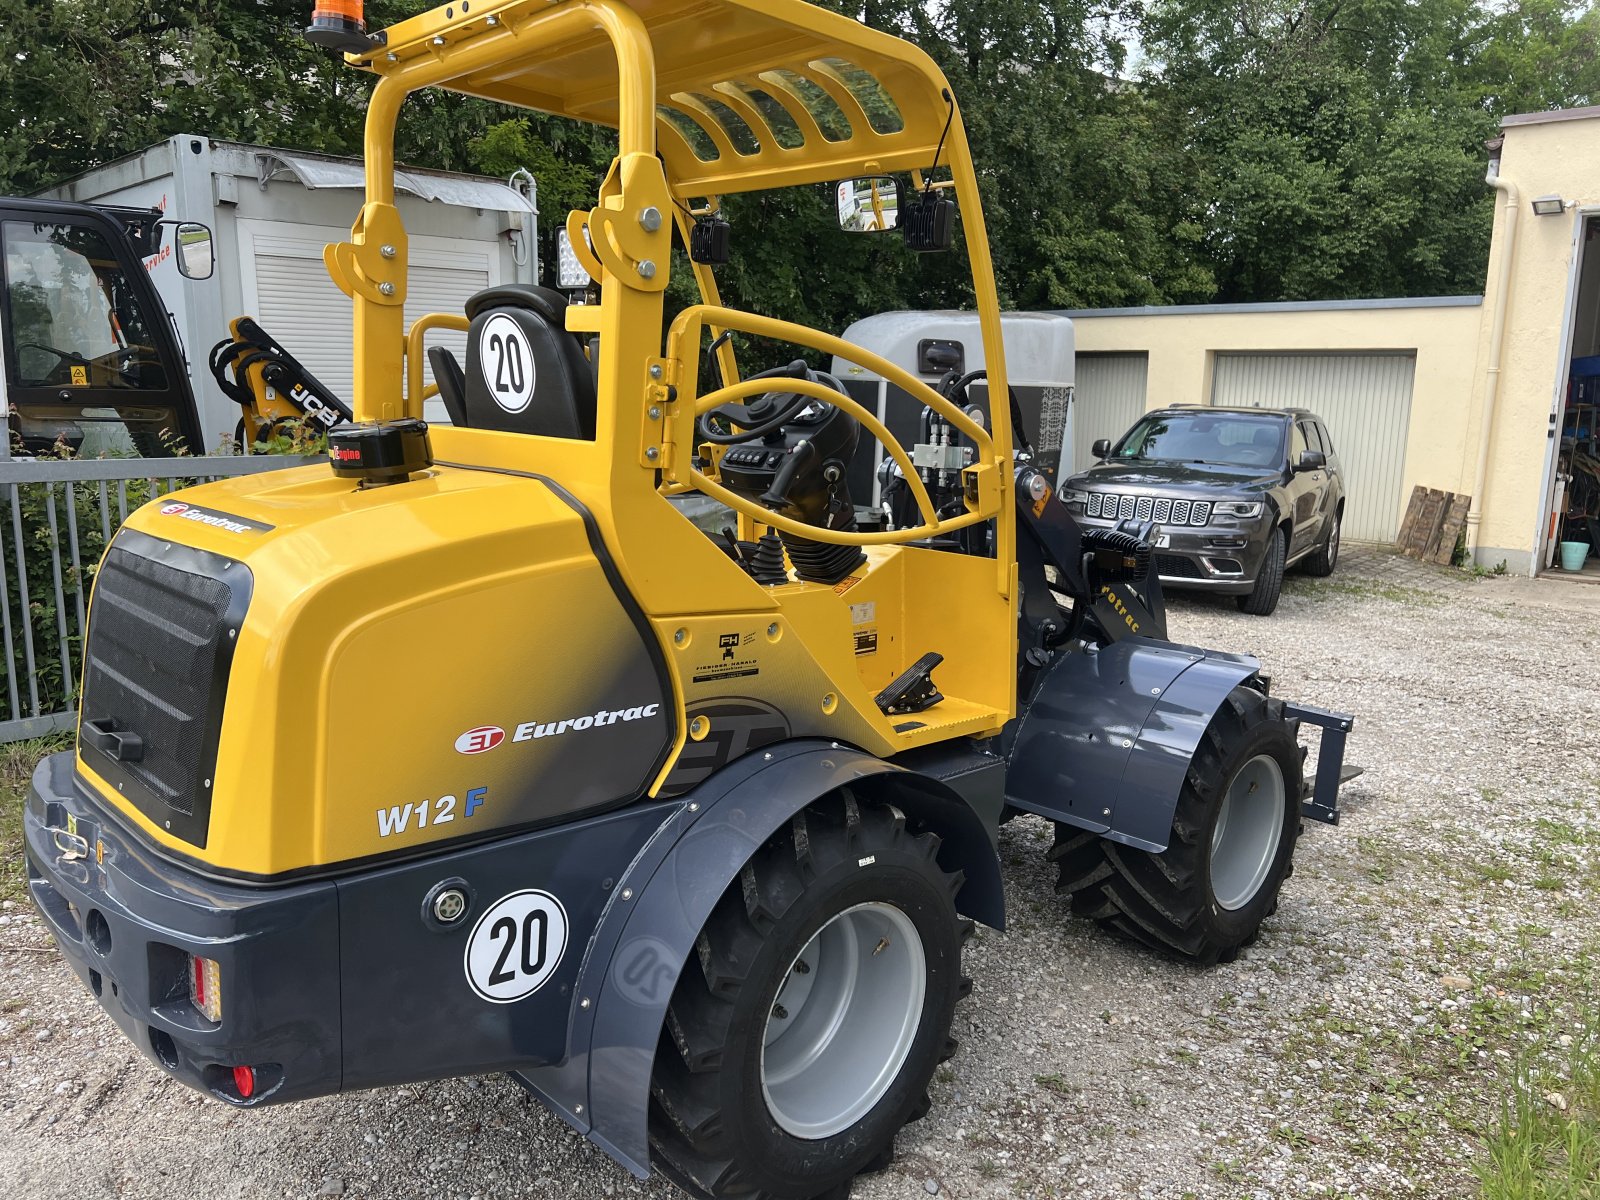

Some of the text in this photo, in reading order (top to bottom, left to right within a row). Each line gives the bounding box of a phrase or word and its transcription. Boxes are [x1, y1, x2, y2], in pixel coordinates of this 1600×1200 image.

[143, 244, 170, 273] ervice
[490, 333, 525, 394] 20
[289, 383, 338, 427] JCB
[330, 445, 361, 462] Engine
[179, 508, 253, 534] Eurotrac
[1101, 585, 1140, 634] rotrac
[720, 635, 738, 646] FH
[456, 703, 660, 753] ET Eurotrac
[376, 786, 488, 838] W12 F
[488, 908, 549, 987] 20
